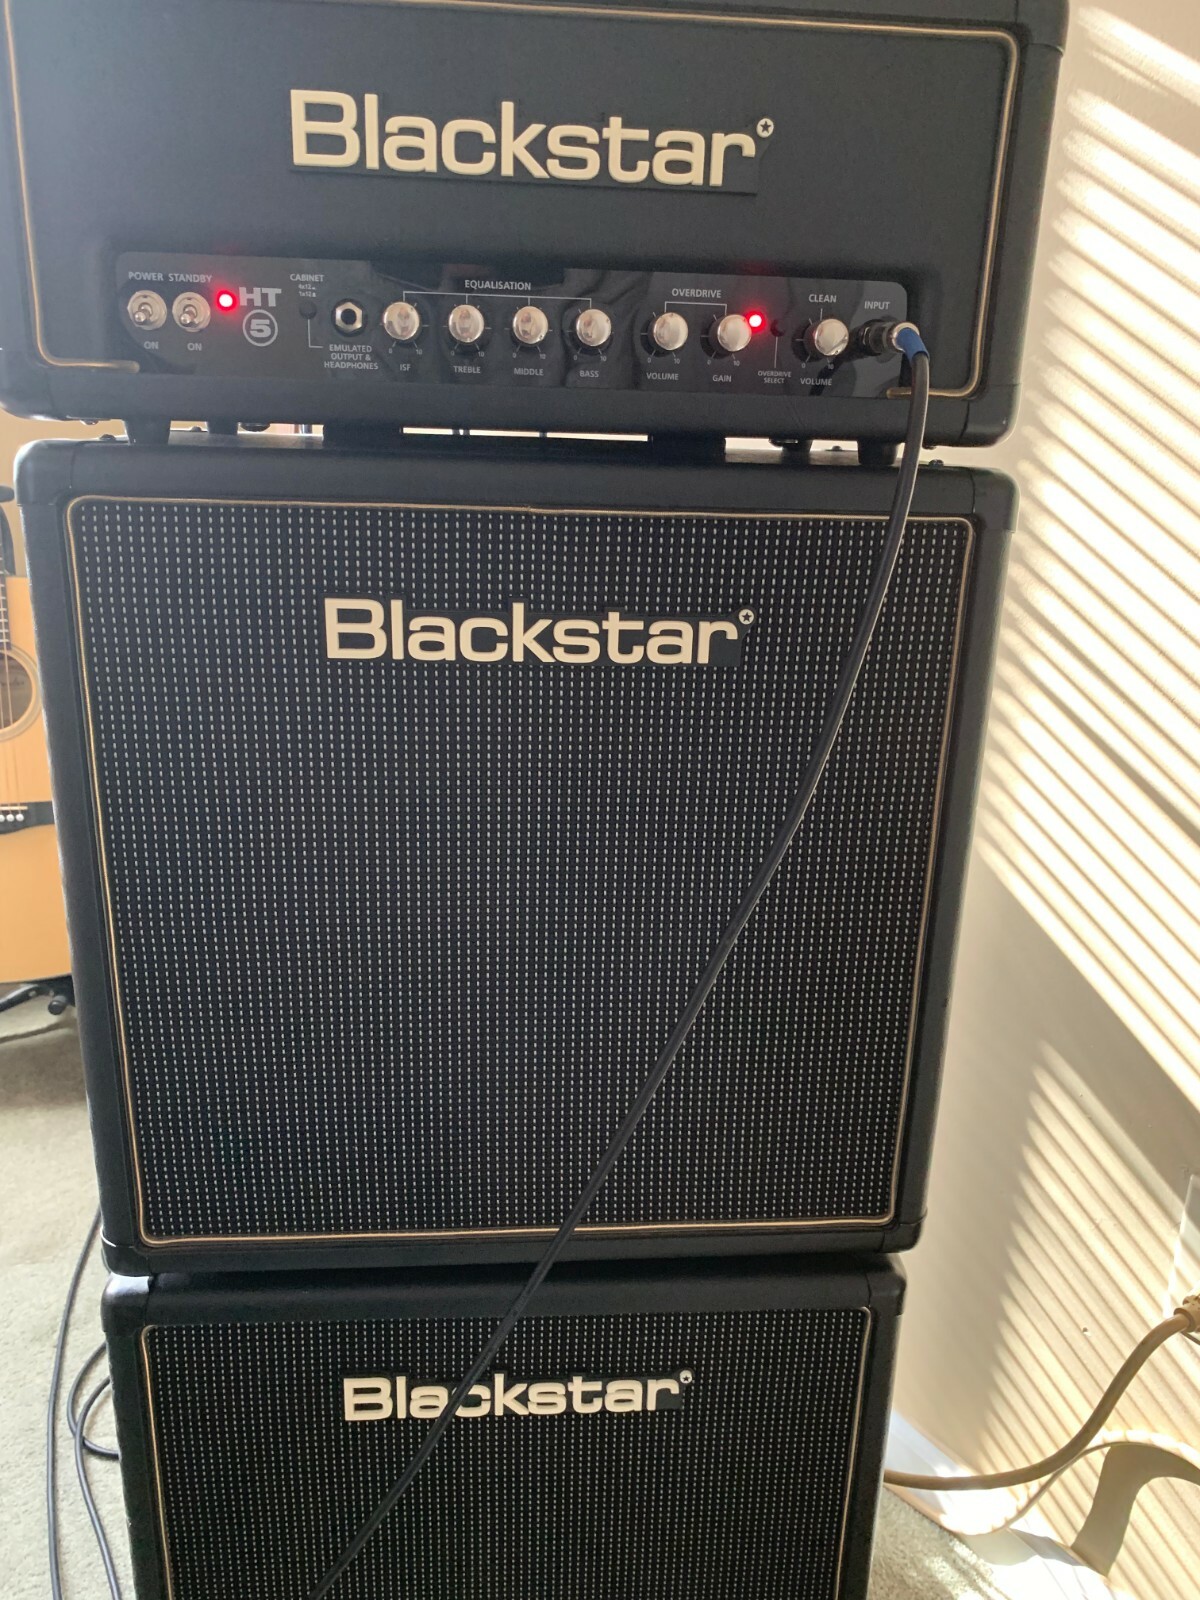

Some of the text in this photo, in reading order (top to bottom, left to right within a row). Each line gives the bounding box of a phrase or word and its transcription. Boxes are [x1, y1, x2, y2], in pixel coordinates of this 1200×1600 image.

[290, 89, 756, 187] Blackstar
[128, 271, 212, 283] POWER STANDBY
[290, 273, 325, 282] CABINET
[464, 279, 531, 291] EQUALISATION
[239, 286, 282, 307] HT
[671, 287, 722, 299] OVERDRIVE
[808, 293, 837, 303] CLEAN
[864, 301, 890, 310] INPUT
[250, 319, 272, 338] 5
[143, 341, 159, 350] ON
[187, 342, 203, 351] ON
[329, 344, 372, 353] EMULATED
[330, 353, 363, 361] OUTPUT
[324, 361, 379, 370] HEADPHONES
[400, 363, 411, 371] ISF
[453, 365, 481, 374] TREBLE
[514, 368, 544, 376] MIDDLE
[580, 370, 599, 378] BASS
[646, 372, 679, 380] VOLUME
[758, 370, 792, 378] OVERDRIVE
[712, 374, 732, 382] GAIN
[800, 378, 833, 386] VOLUME
[324, 597, 738, 664] Blackstar
[343, 1373, 680, 1421] Blackstar
